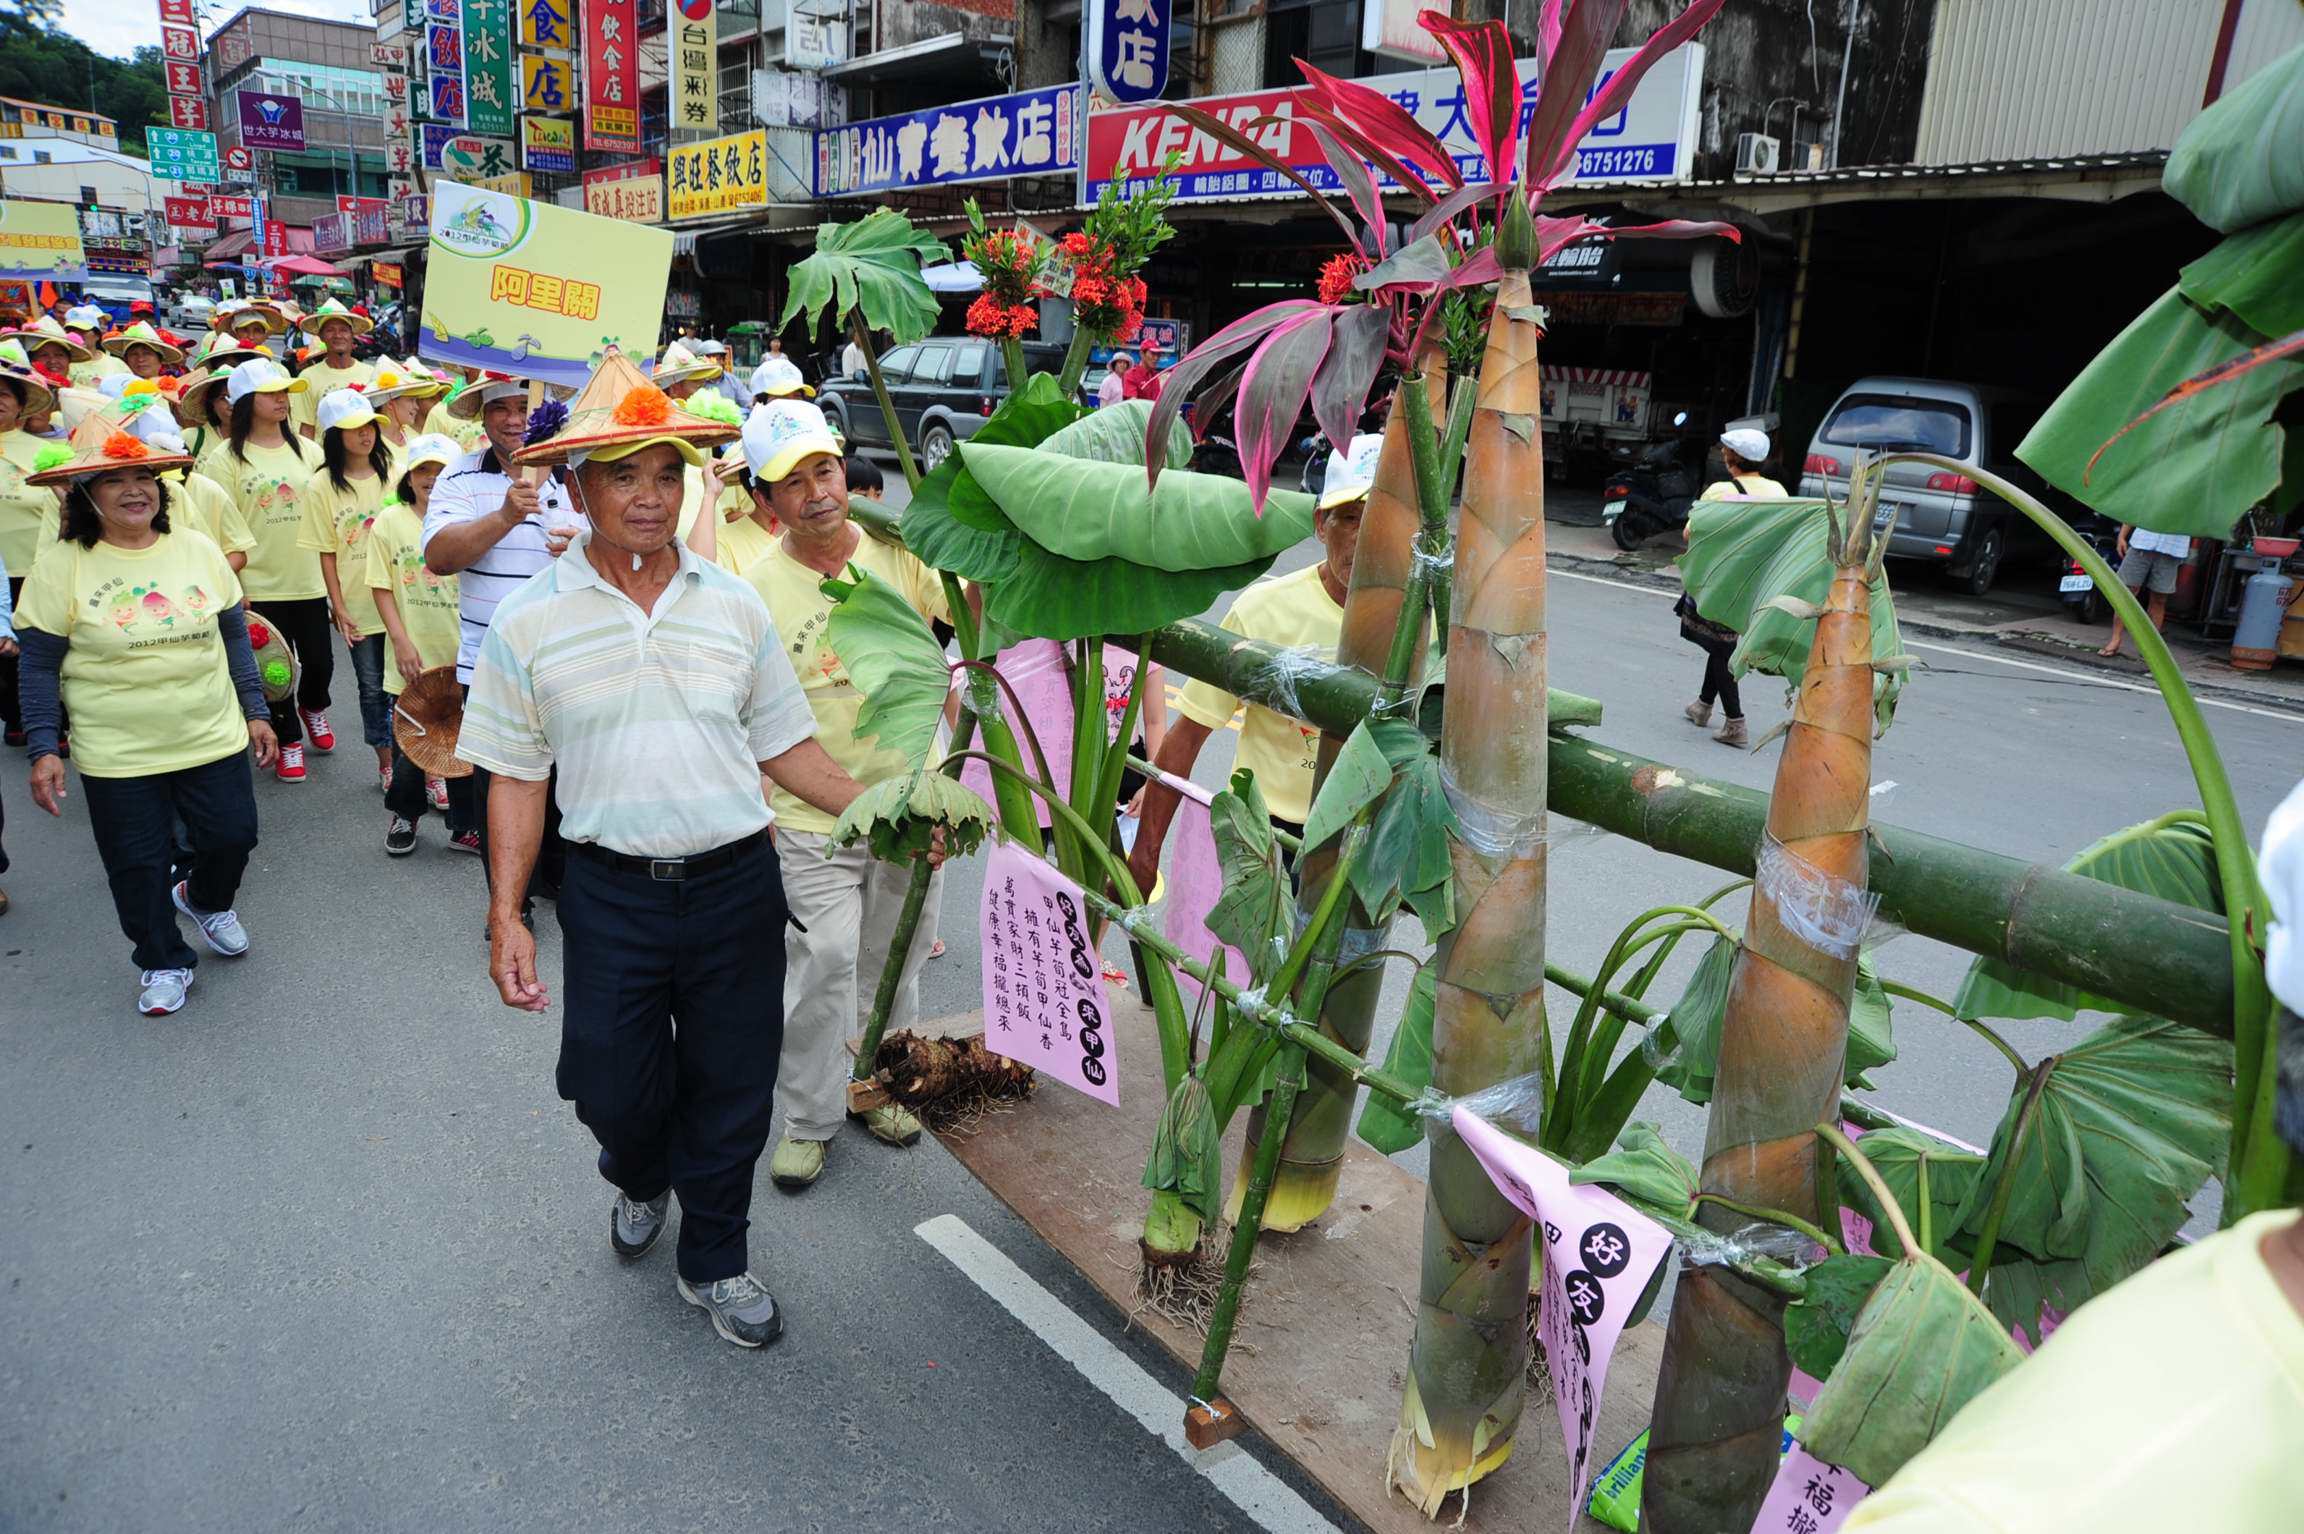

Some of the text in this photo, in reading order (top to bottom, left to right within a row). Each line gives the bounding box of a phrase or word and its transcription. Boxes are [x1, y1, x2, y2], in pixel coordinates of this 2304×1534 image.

[599, 0, 625, 102] 飲食店
[682, 24, 709, 122] 台灣彩券
[478, 144, 513, 178] 茶
[672, 140, 762, 195] 興旺餐飲店
[490, 264, 601, 321] 阿里關
[988, 888, 1013, 1033] 健康幸福攏總來
[1004, 876, 1032, 1023] 萬貫家財三頓飯
[1024, 908, 1053, 1051] 擁有芋筍甲仙香
[1043, 896, 1072, 1041] 甲仙芋筍冠全島
[1787, 1466, 1843, 1534] 福攏
